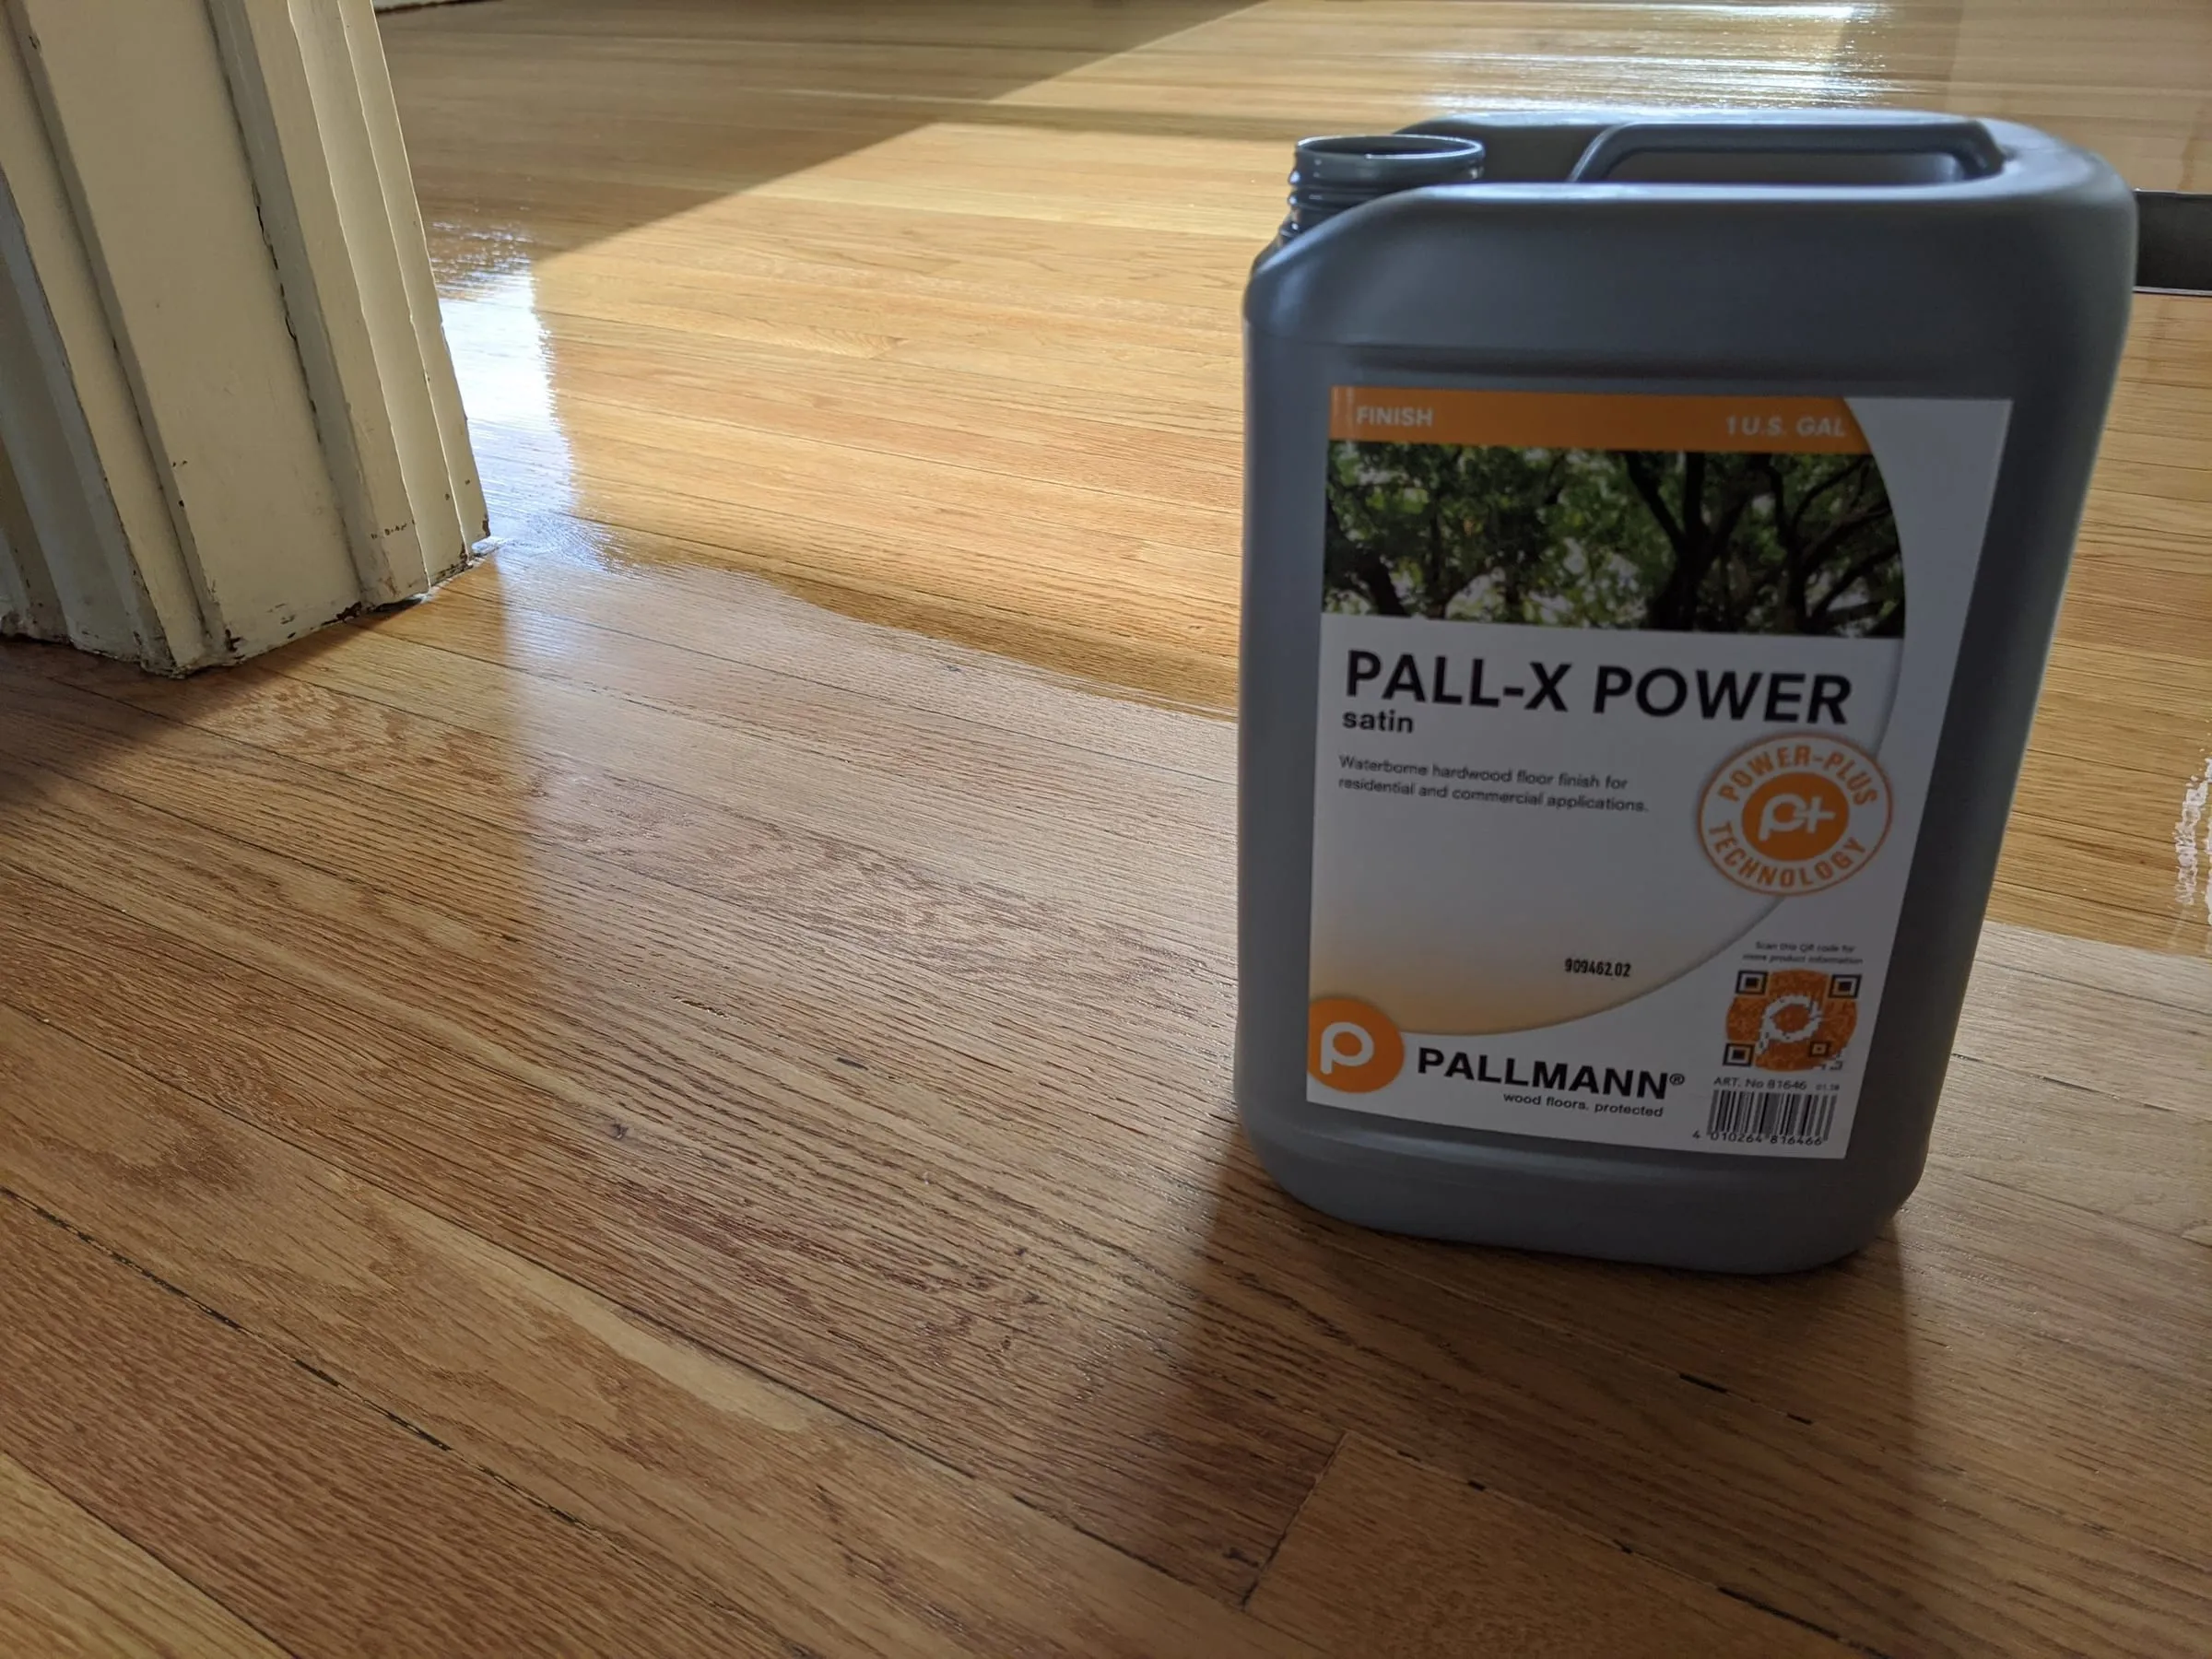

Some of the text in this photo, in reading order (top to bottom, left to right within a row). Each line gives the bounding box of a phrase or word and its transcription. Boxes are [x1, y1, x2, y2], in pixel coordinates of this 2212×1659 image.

[1356, 406, 1434, 427] FINISH
[1726, 415, 1737, 436] 1
[1795, 417, 1847, 437] GAL
[1346, 649, 1853, 724] PALL-X POWER
[1342, 709, 1414, 734] satin
[1432, 764, 1512, 783] hardwood
[1516, 769, 1554, 786] floor
[1558, 773, 1600, 789] finish
[1605, 775, 1628, 790] for
[1718, 745, 1878, 806] POWER-PLUS
[1338, 777, 1649, 814] residential and commercial applications.
[1709, 822, 1866, 888] TECHNOLOGY
[1745, 1079, 1764, 1088] No
[1503, 1093, 1542, 1107] wood
[1594, 1102, 1664, 1117] protected
[1710, 1132, 1763, 1144] 010264
[1770, 1135, 1823, 1146] 816466
